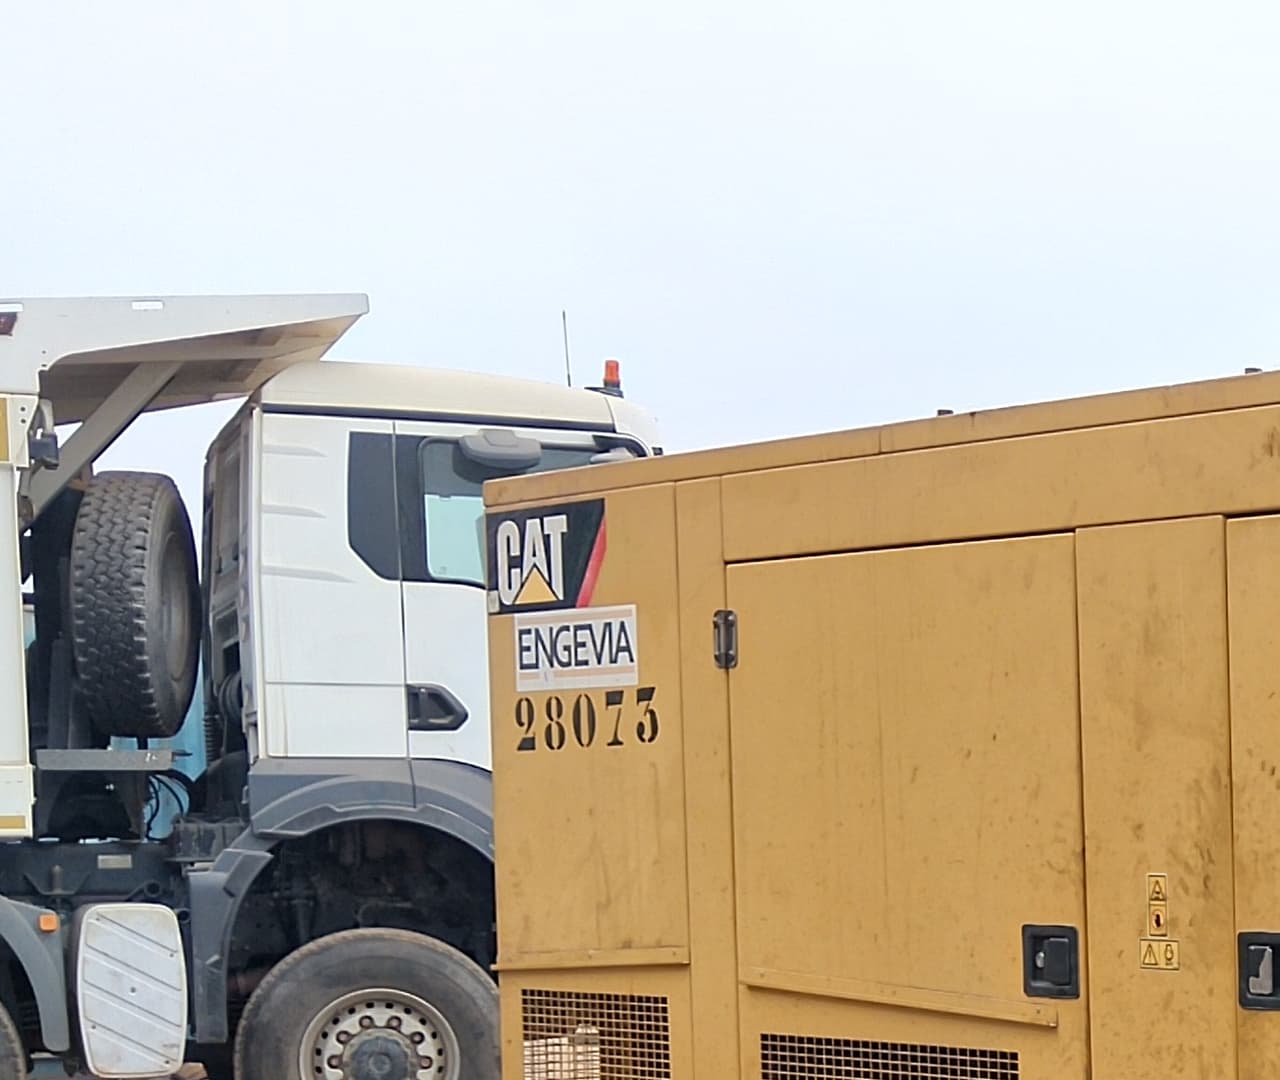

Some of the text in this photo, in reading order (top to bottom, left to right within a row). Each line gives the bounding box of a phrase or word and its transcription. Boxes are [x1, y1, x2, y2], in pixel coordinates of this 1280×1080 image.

[496, 514, 568, 606] CAT
[518, 620, 635, 670] ENGEVIA
[514, 686, 660, 752] 28073
